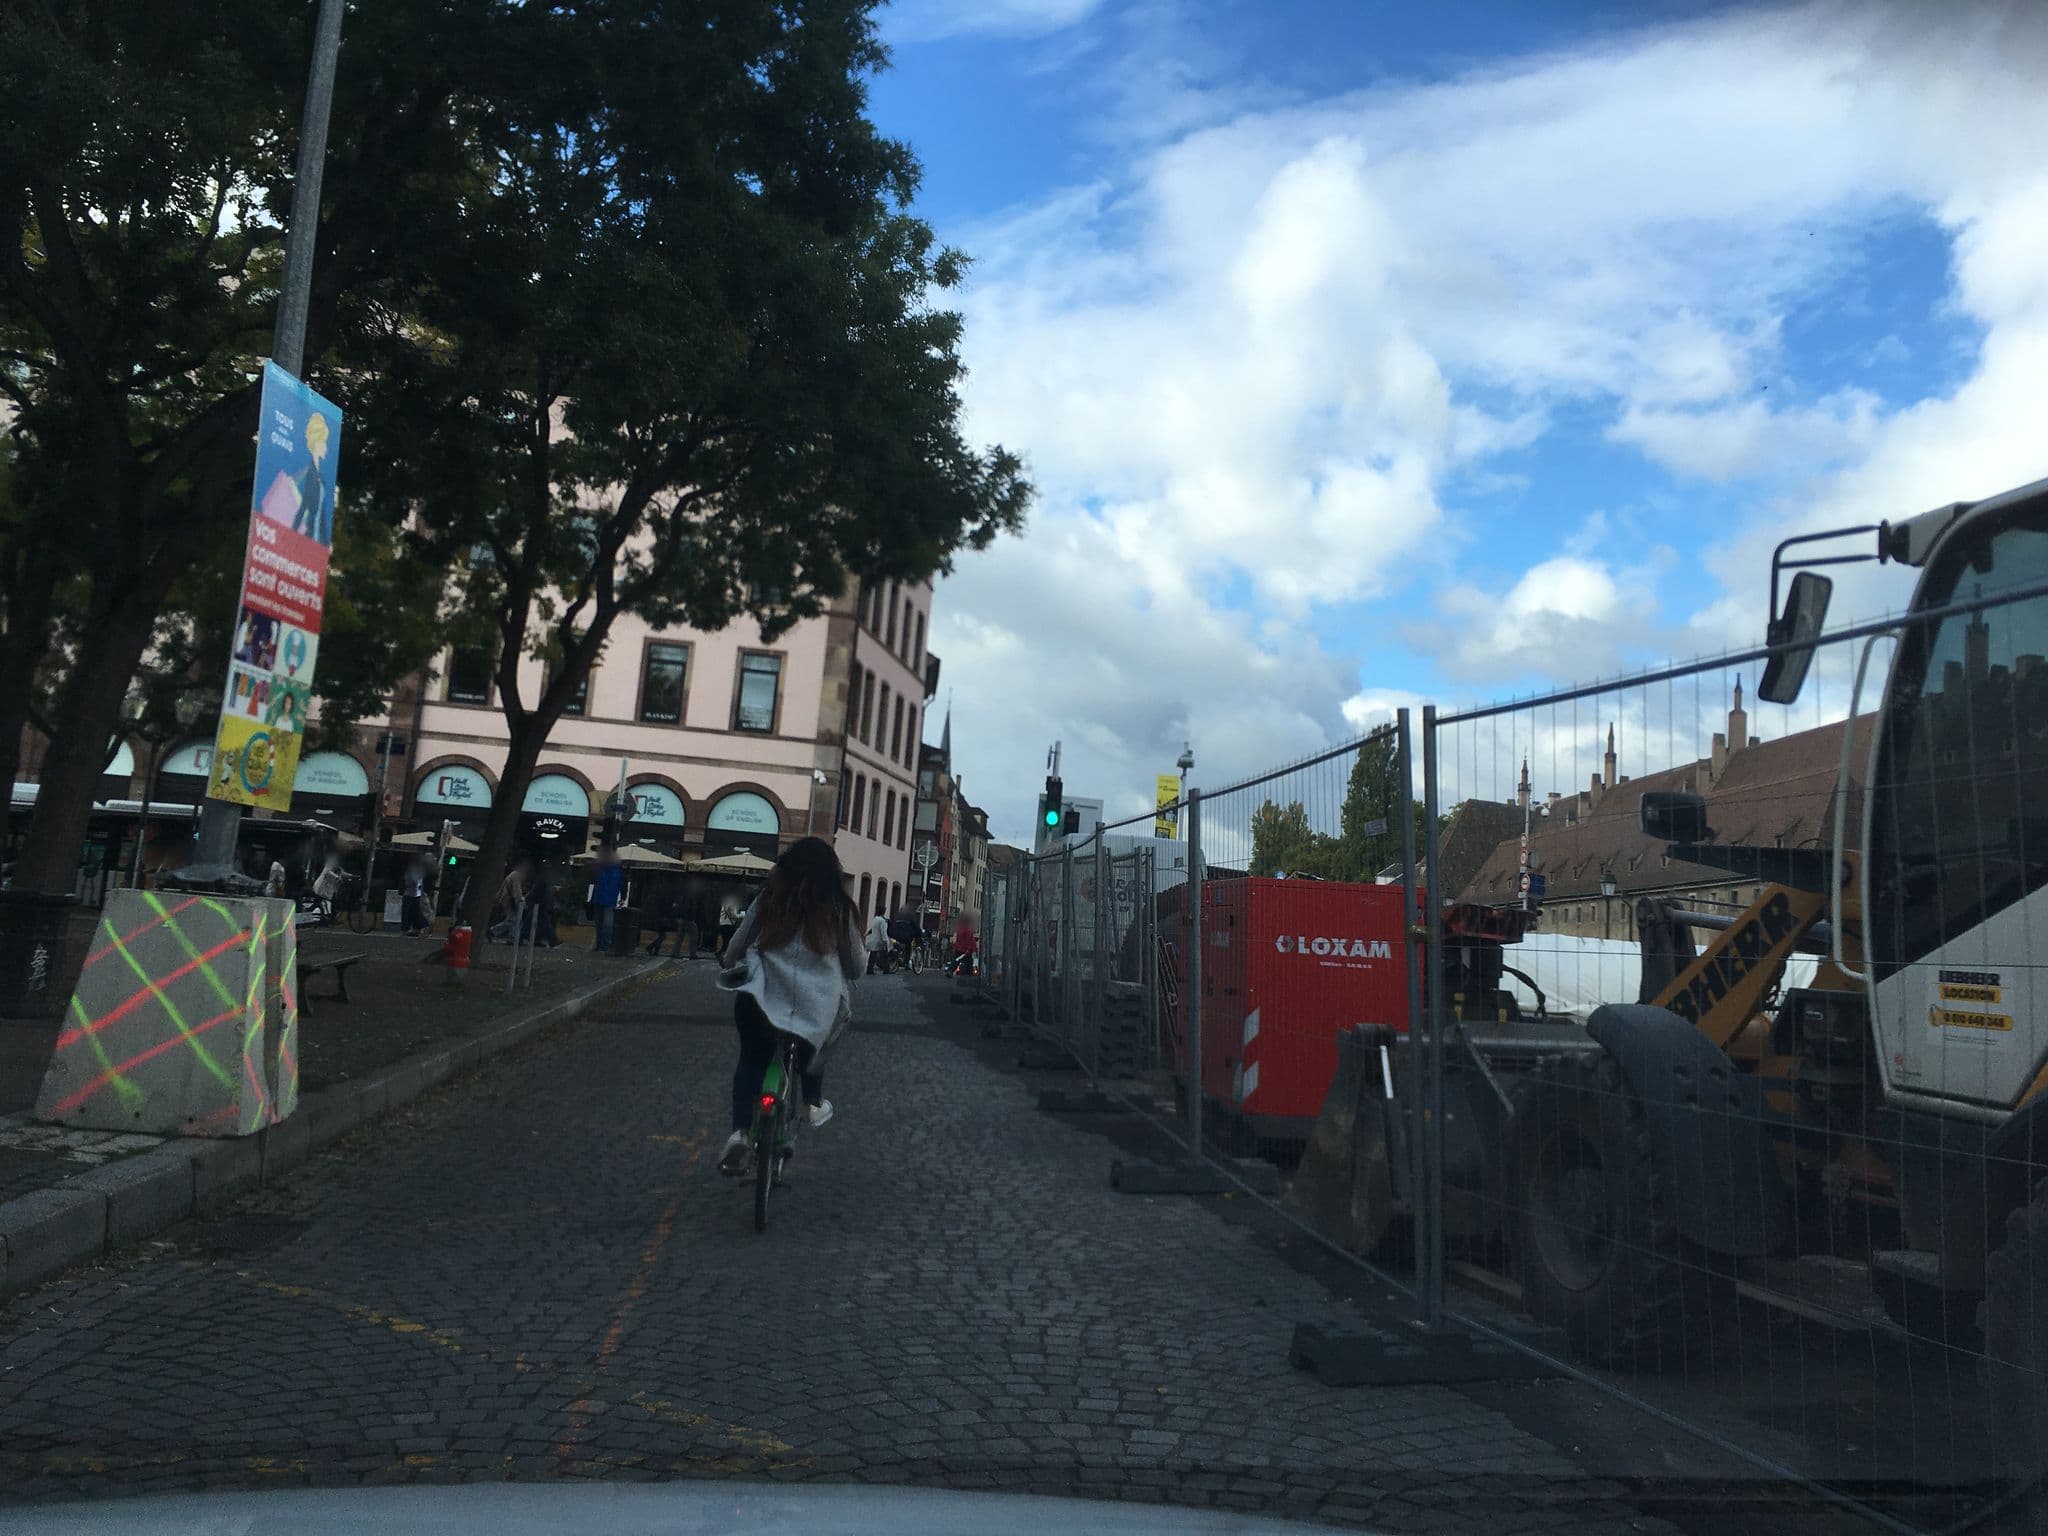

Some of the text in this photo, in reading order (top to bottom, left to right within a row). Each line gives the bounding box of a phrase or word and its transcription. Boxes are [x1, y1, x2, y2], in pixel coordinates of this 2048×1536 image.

[248, 566, 276, 592] sont
[276, 580, 322, 611] ouverts
[535, 817, 565, 830] RAVEN
[1297, 936, 1392, 959] LOXAM
[1944, 987, 1996, 1002] LOCATION
